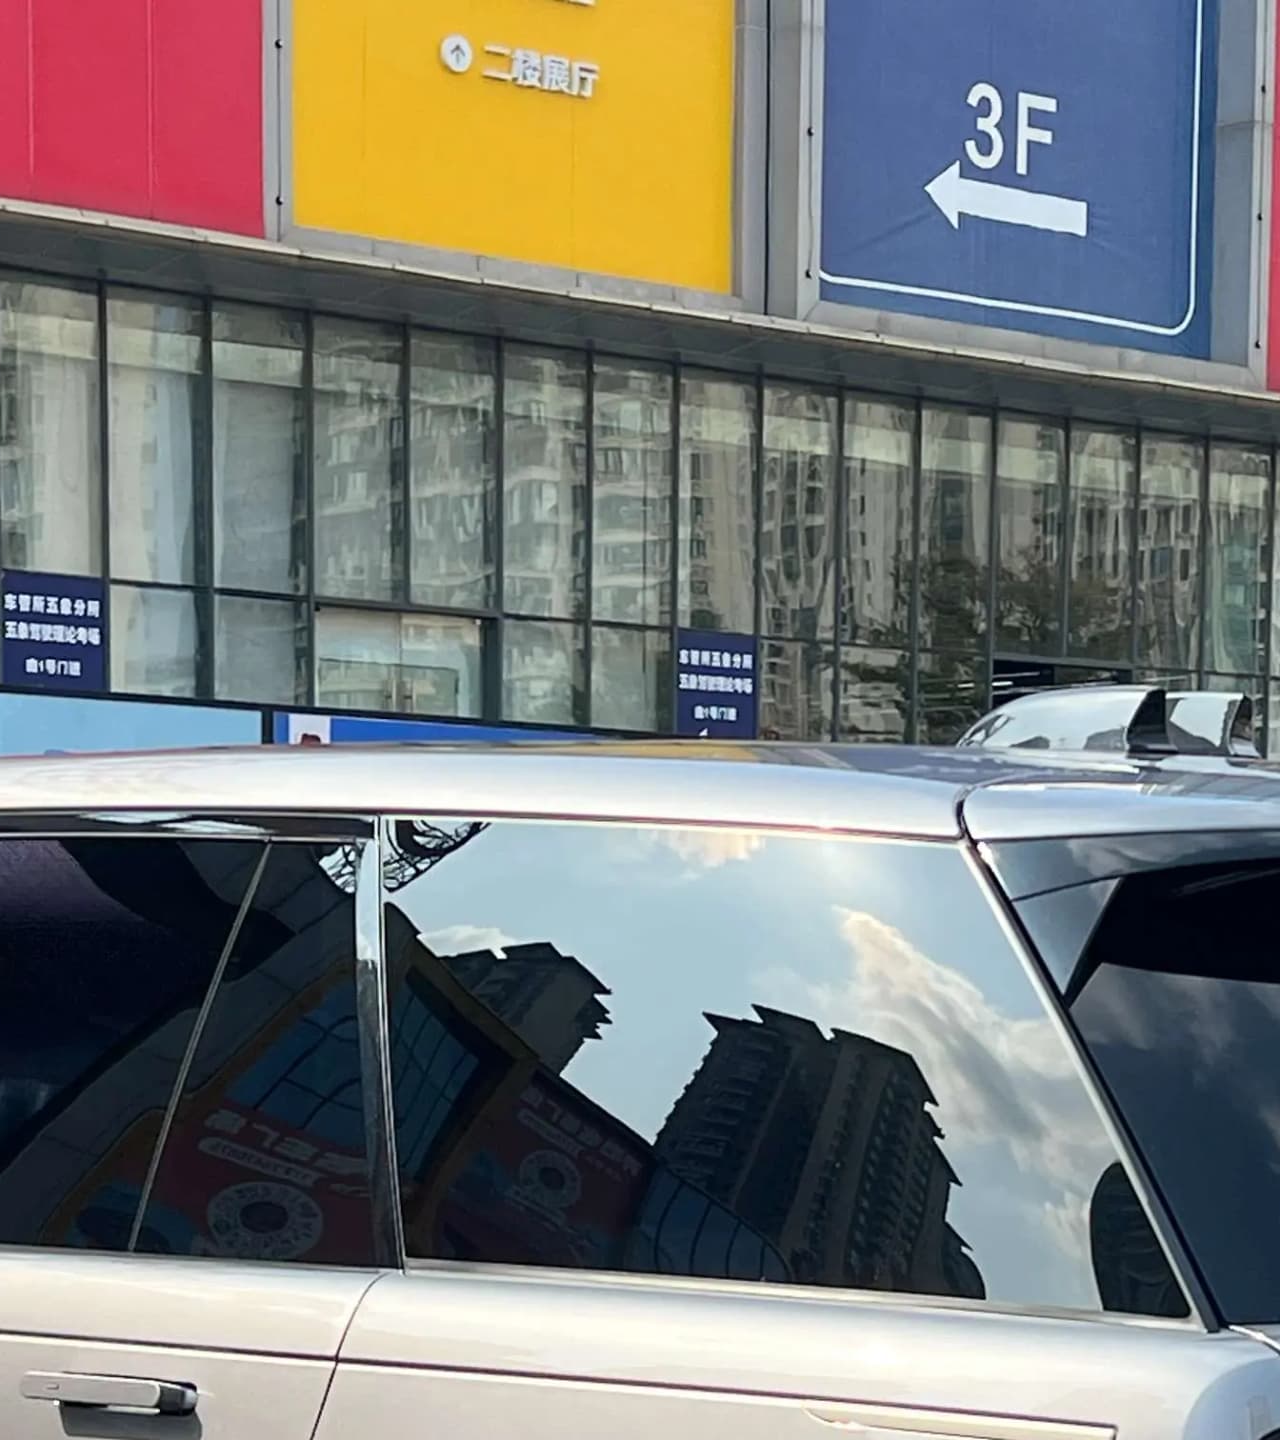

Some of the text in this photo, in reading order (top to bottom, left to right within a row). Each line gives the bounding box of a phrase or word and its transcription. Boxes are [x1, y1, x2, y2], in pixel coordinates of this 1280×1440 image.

[482, 45, 600, 98] 二楼展厅
[964, 81, 1058, 176] 3F
